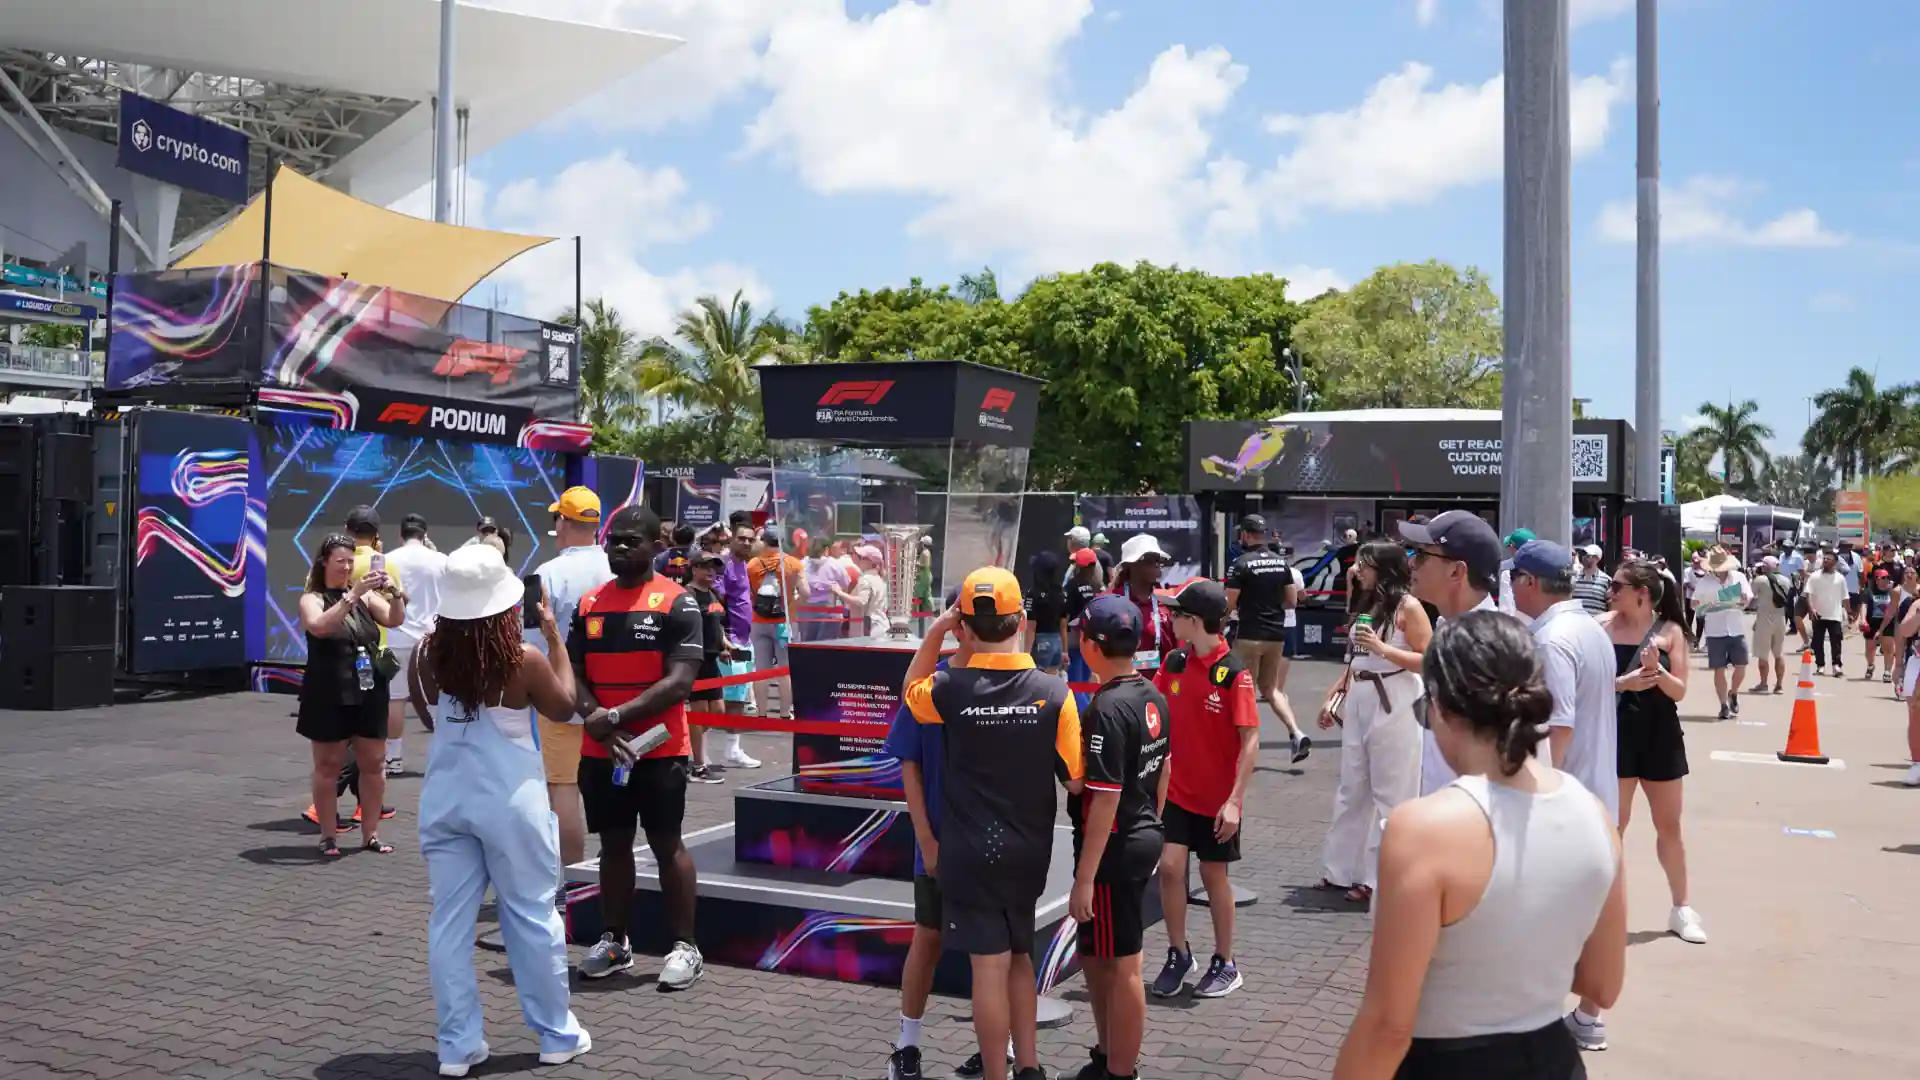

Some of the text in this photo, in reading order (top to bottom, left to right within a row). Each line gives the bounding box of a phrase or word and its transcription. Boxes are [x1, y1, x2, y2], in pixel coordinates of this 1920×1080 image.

[156, 134, 241, 175] crypto.com
[816, 408, 834, 423] FIA
[430, 406, 507, 436] PODIUM
[1438, 439, 1503, 450] GET READ
[1447, 452, 1502, 462] CUSTOM
[665, 467, 696, 477] QATAR
[1452, 465, 1487, 475] YOUR
[1097, 520, 1198, 529] ARTIST SERIES
[837, 682, 890, 692] GIUSEPPE FARINA
[960, 705, 1038, 716] McLaren
